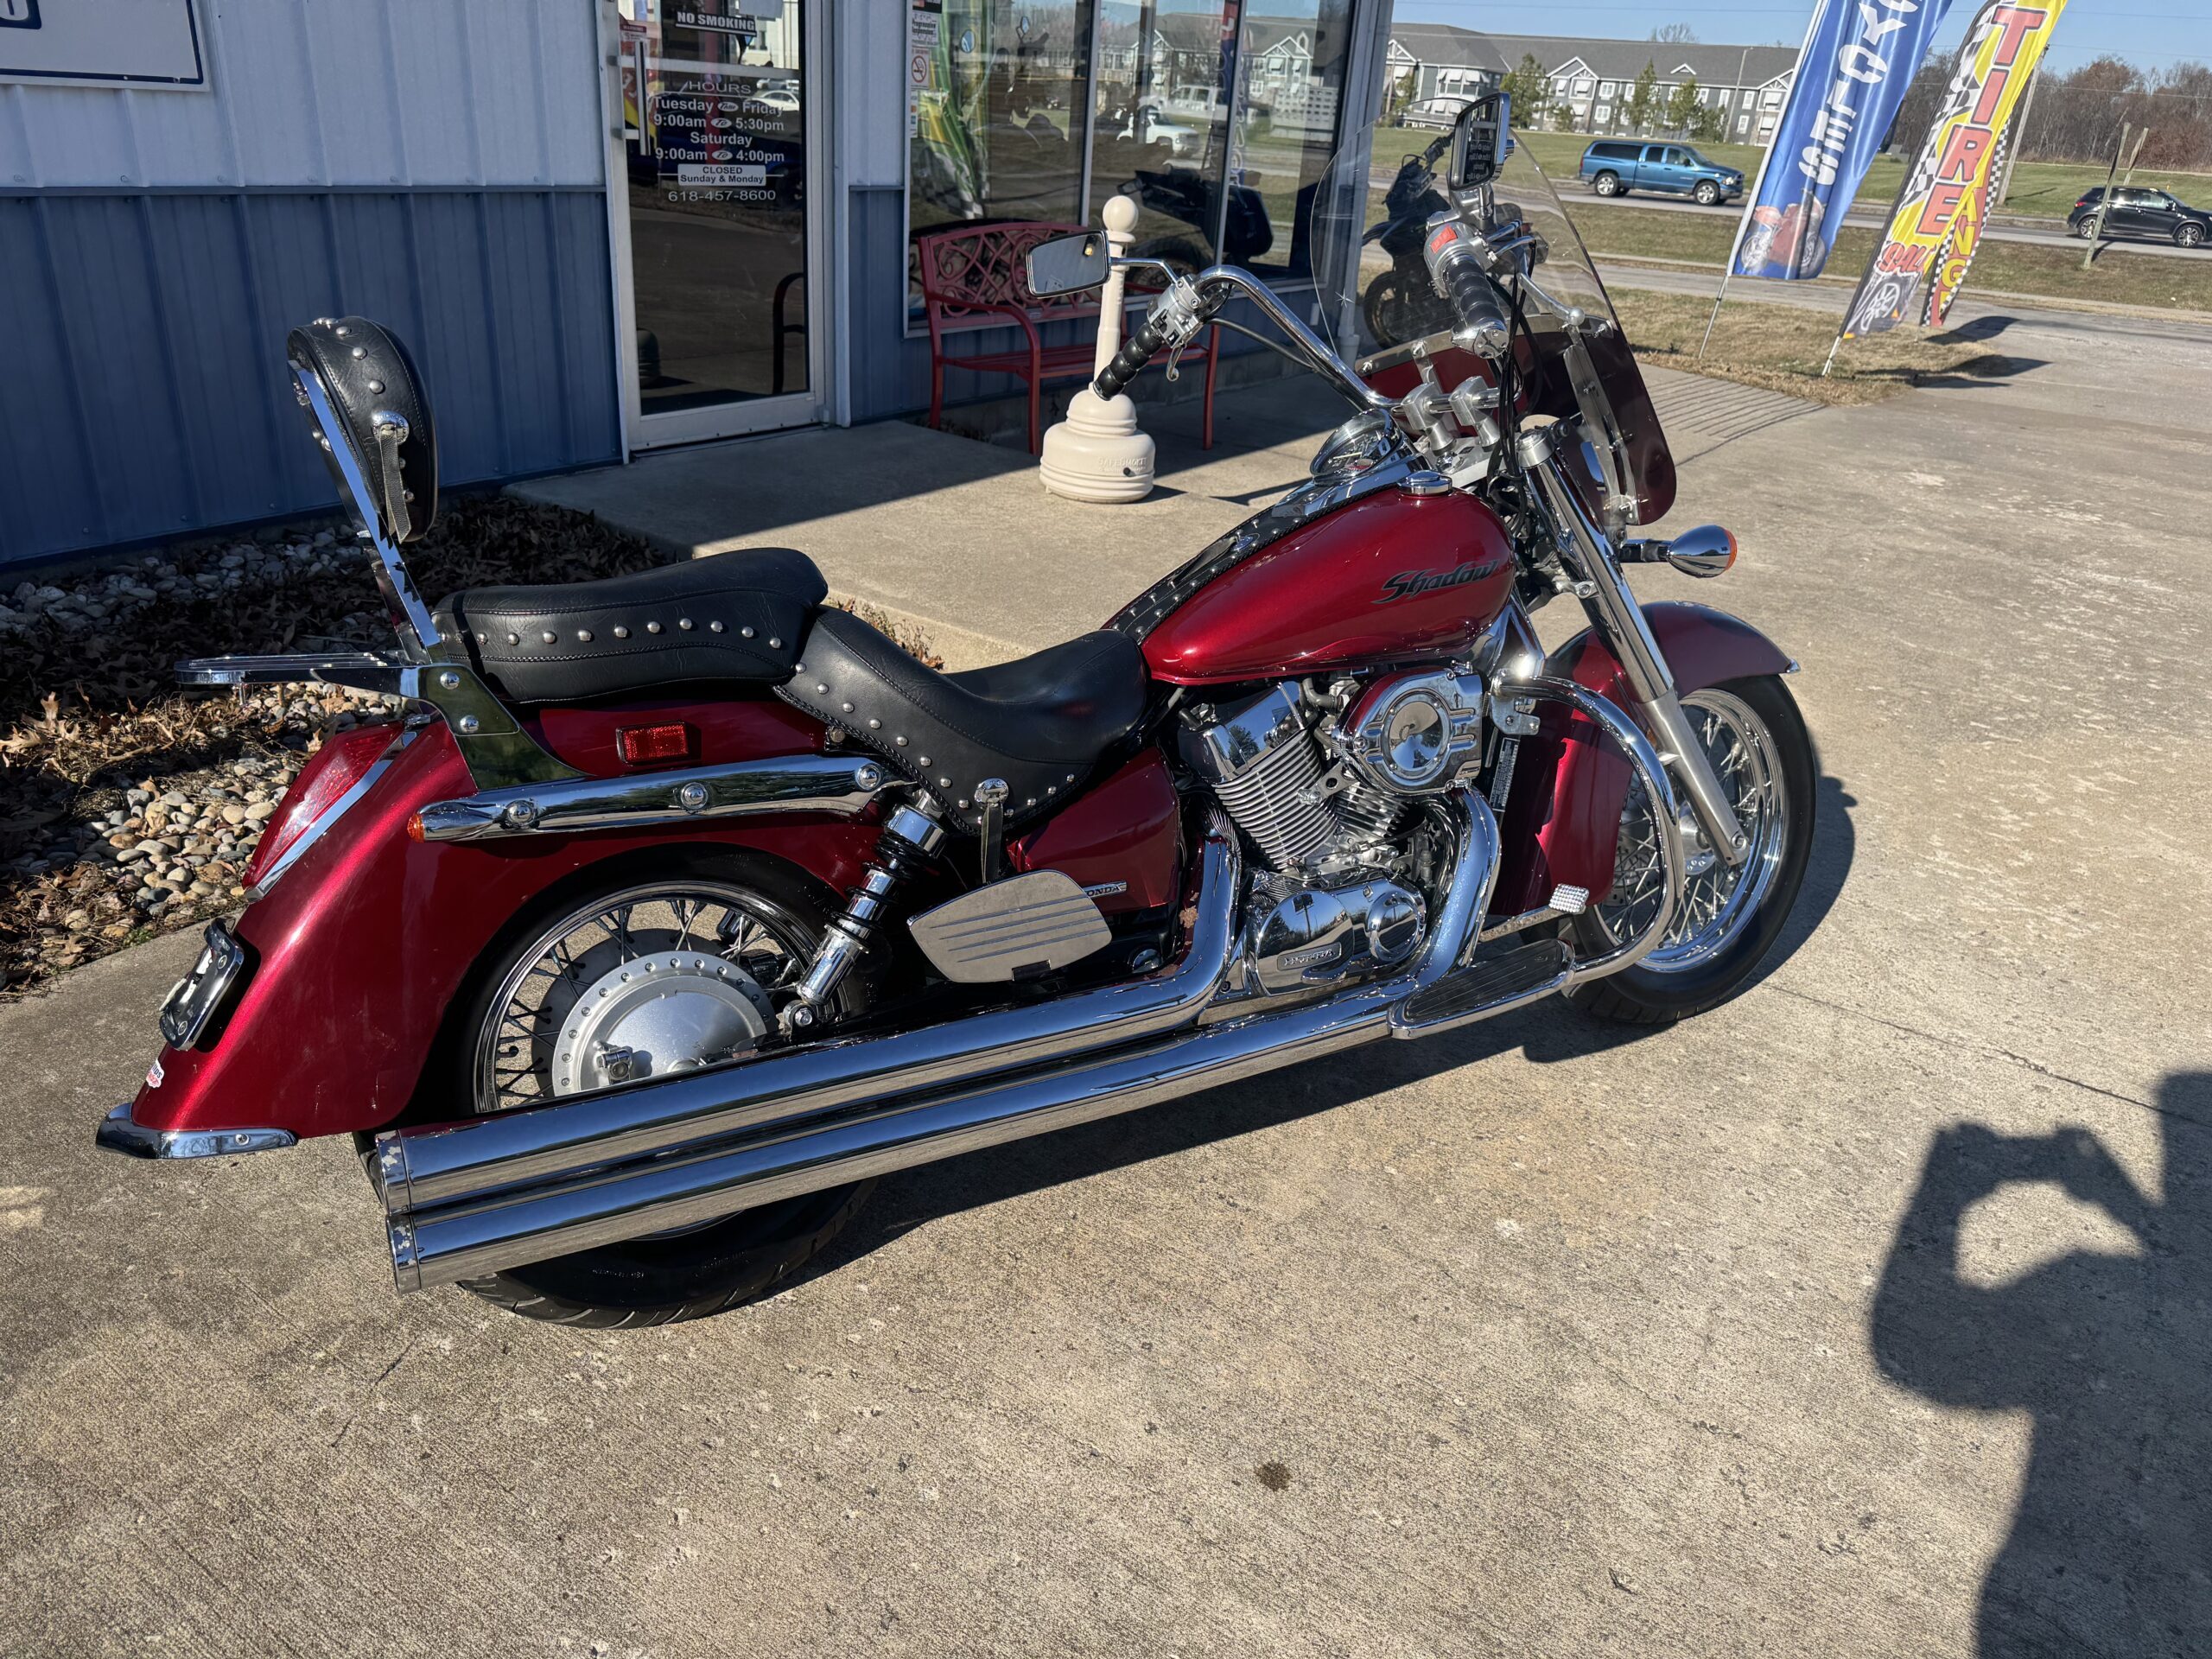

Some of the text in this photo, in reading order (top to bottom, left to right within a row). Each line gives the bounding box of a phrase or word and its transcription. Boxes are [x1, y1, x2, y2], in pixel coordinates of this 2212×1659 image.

[677, 11, 756, 31] NO SMOKING
[689, 80, 752, 94] HOURS
[653, 97, 714, 113] Tuesday
[742, 102, 784, 118] Friday
[654, 114, 707, 128] 9:00am
[735, 118, 785, 133] 5:30pm
[1916, 5, 2047, 235] TIRE
[690, 132, 753, 148] Saturday
[655, 148, 708, 161] 9:00am
[736, 149, 785, 164] 4:00pm
[702, 166, 743, 175] CLOSED
[680, 175, 716, 184] Sunday
[728, 175, 764, 185] Monday
[668, 190, 777, 202] 618-457-8600
[1876, 241, 1937, 274] SAL
[1370, 559, 1502, 605] Shadow
[1086, 884, 1121, 897] ONDA
